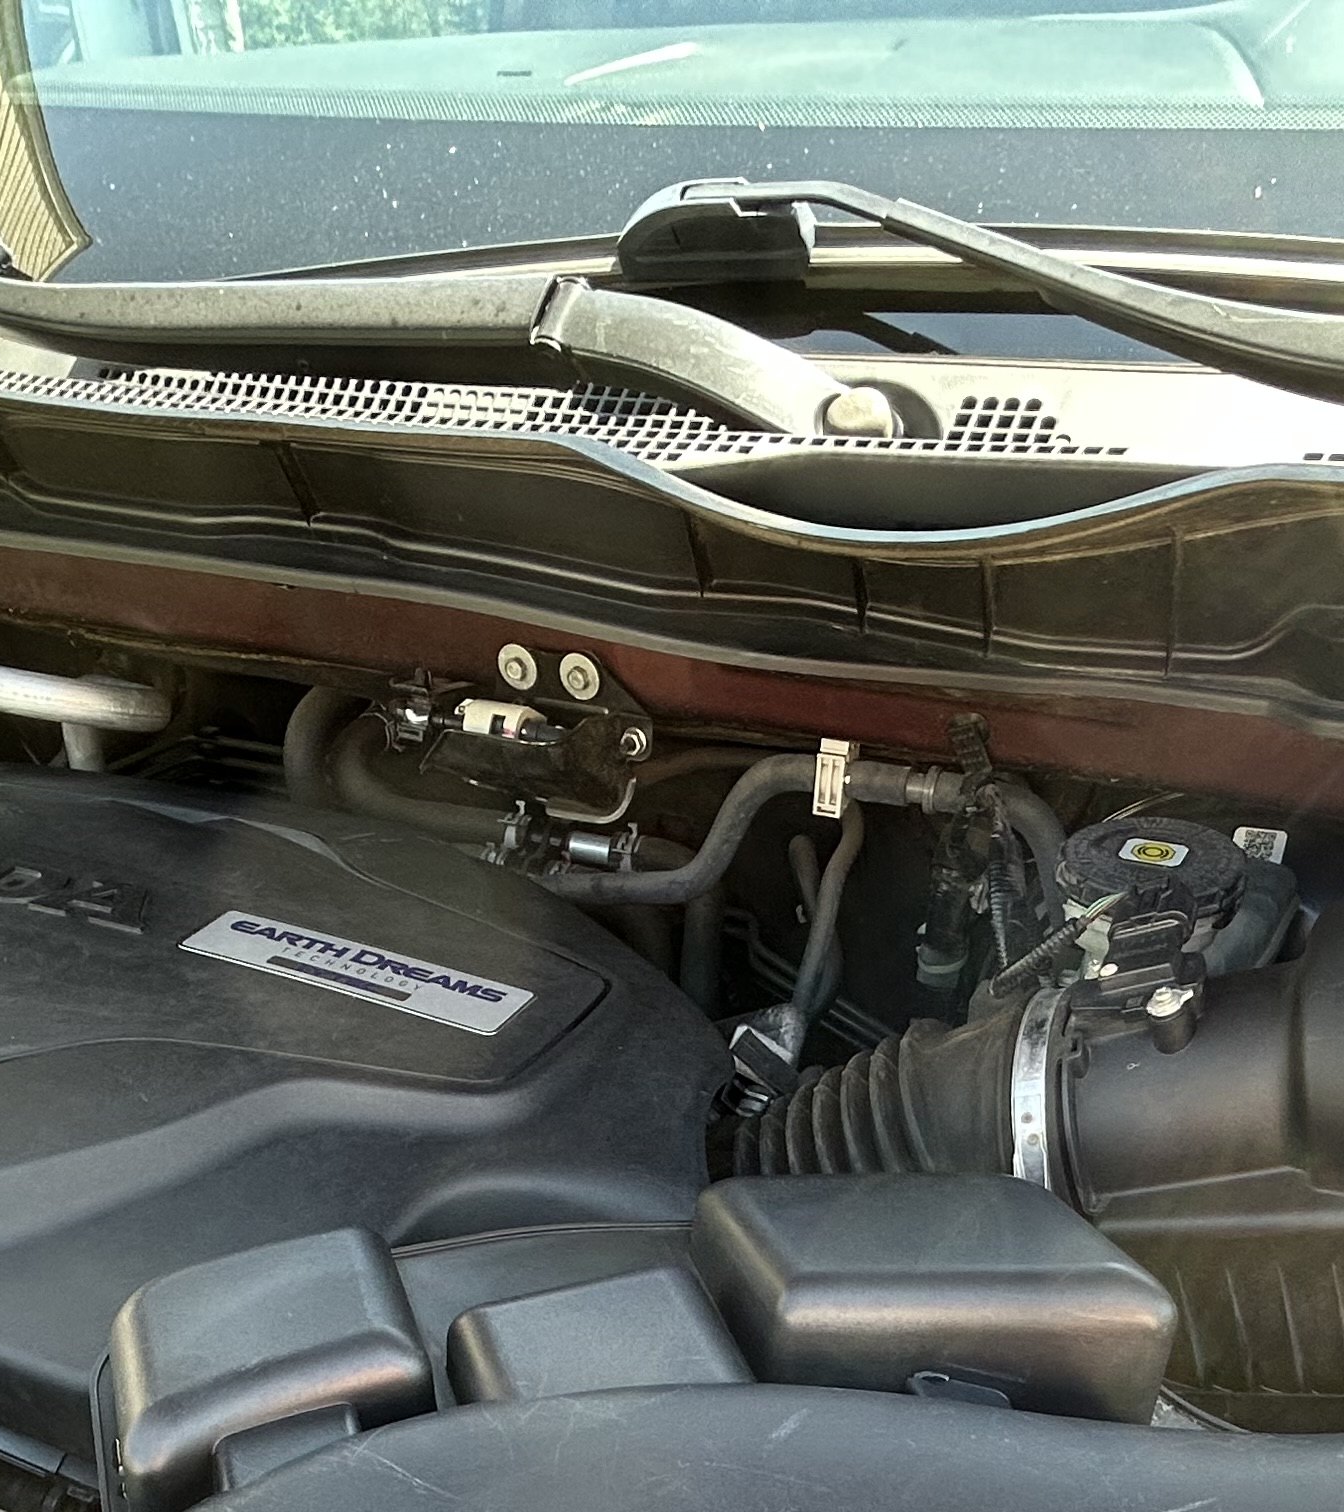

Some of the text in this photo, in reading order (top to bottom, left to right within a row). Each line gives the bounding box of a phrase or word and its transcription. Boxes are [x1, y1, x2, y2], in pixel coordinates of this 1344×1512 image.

[229, 919, 352, 960] EARTH
[348, 948, 509, 1003] DREAMS
[280, 946, 426, 992] TECHNOLOGY
